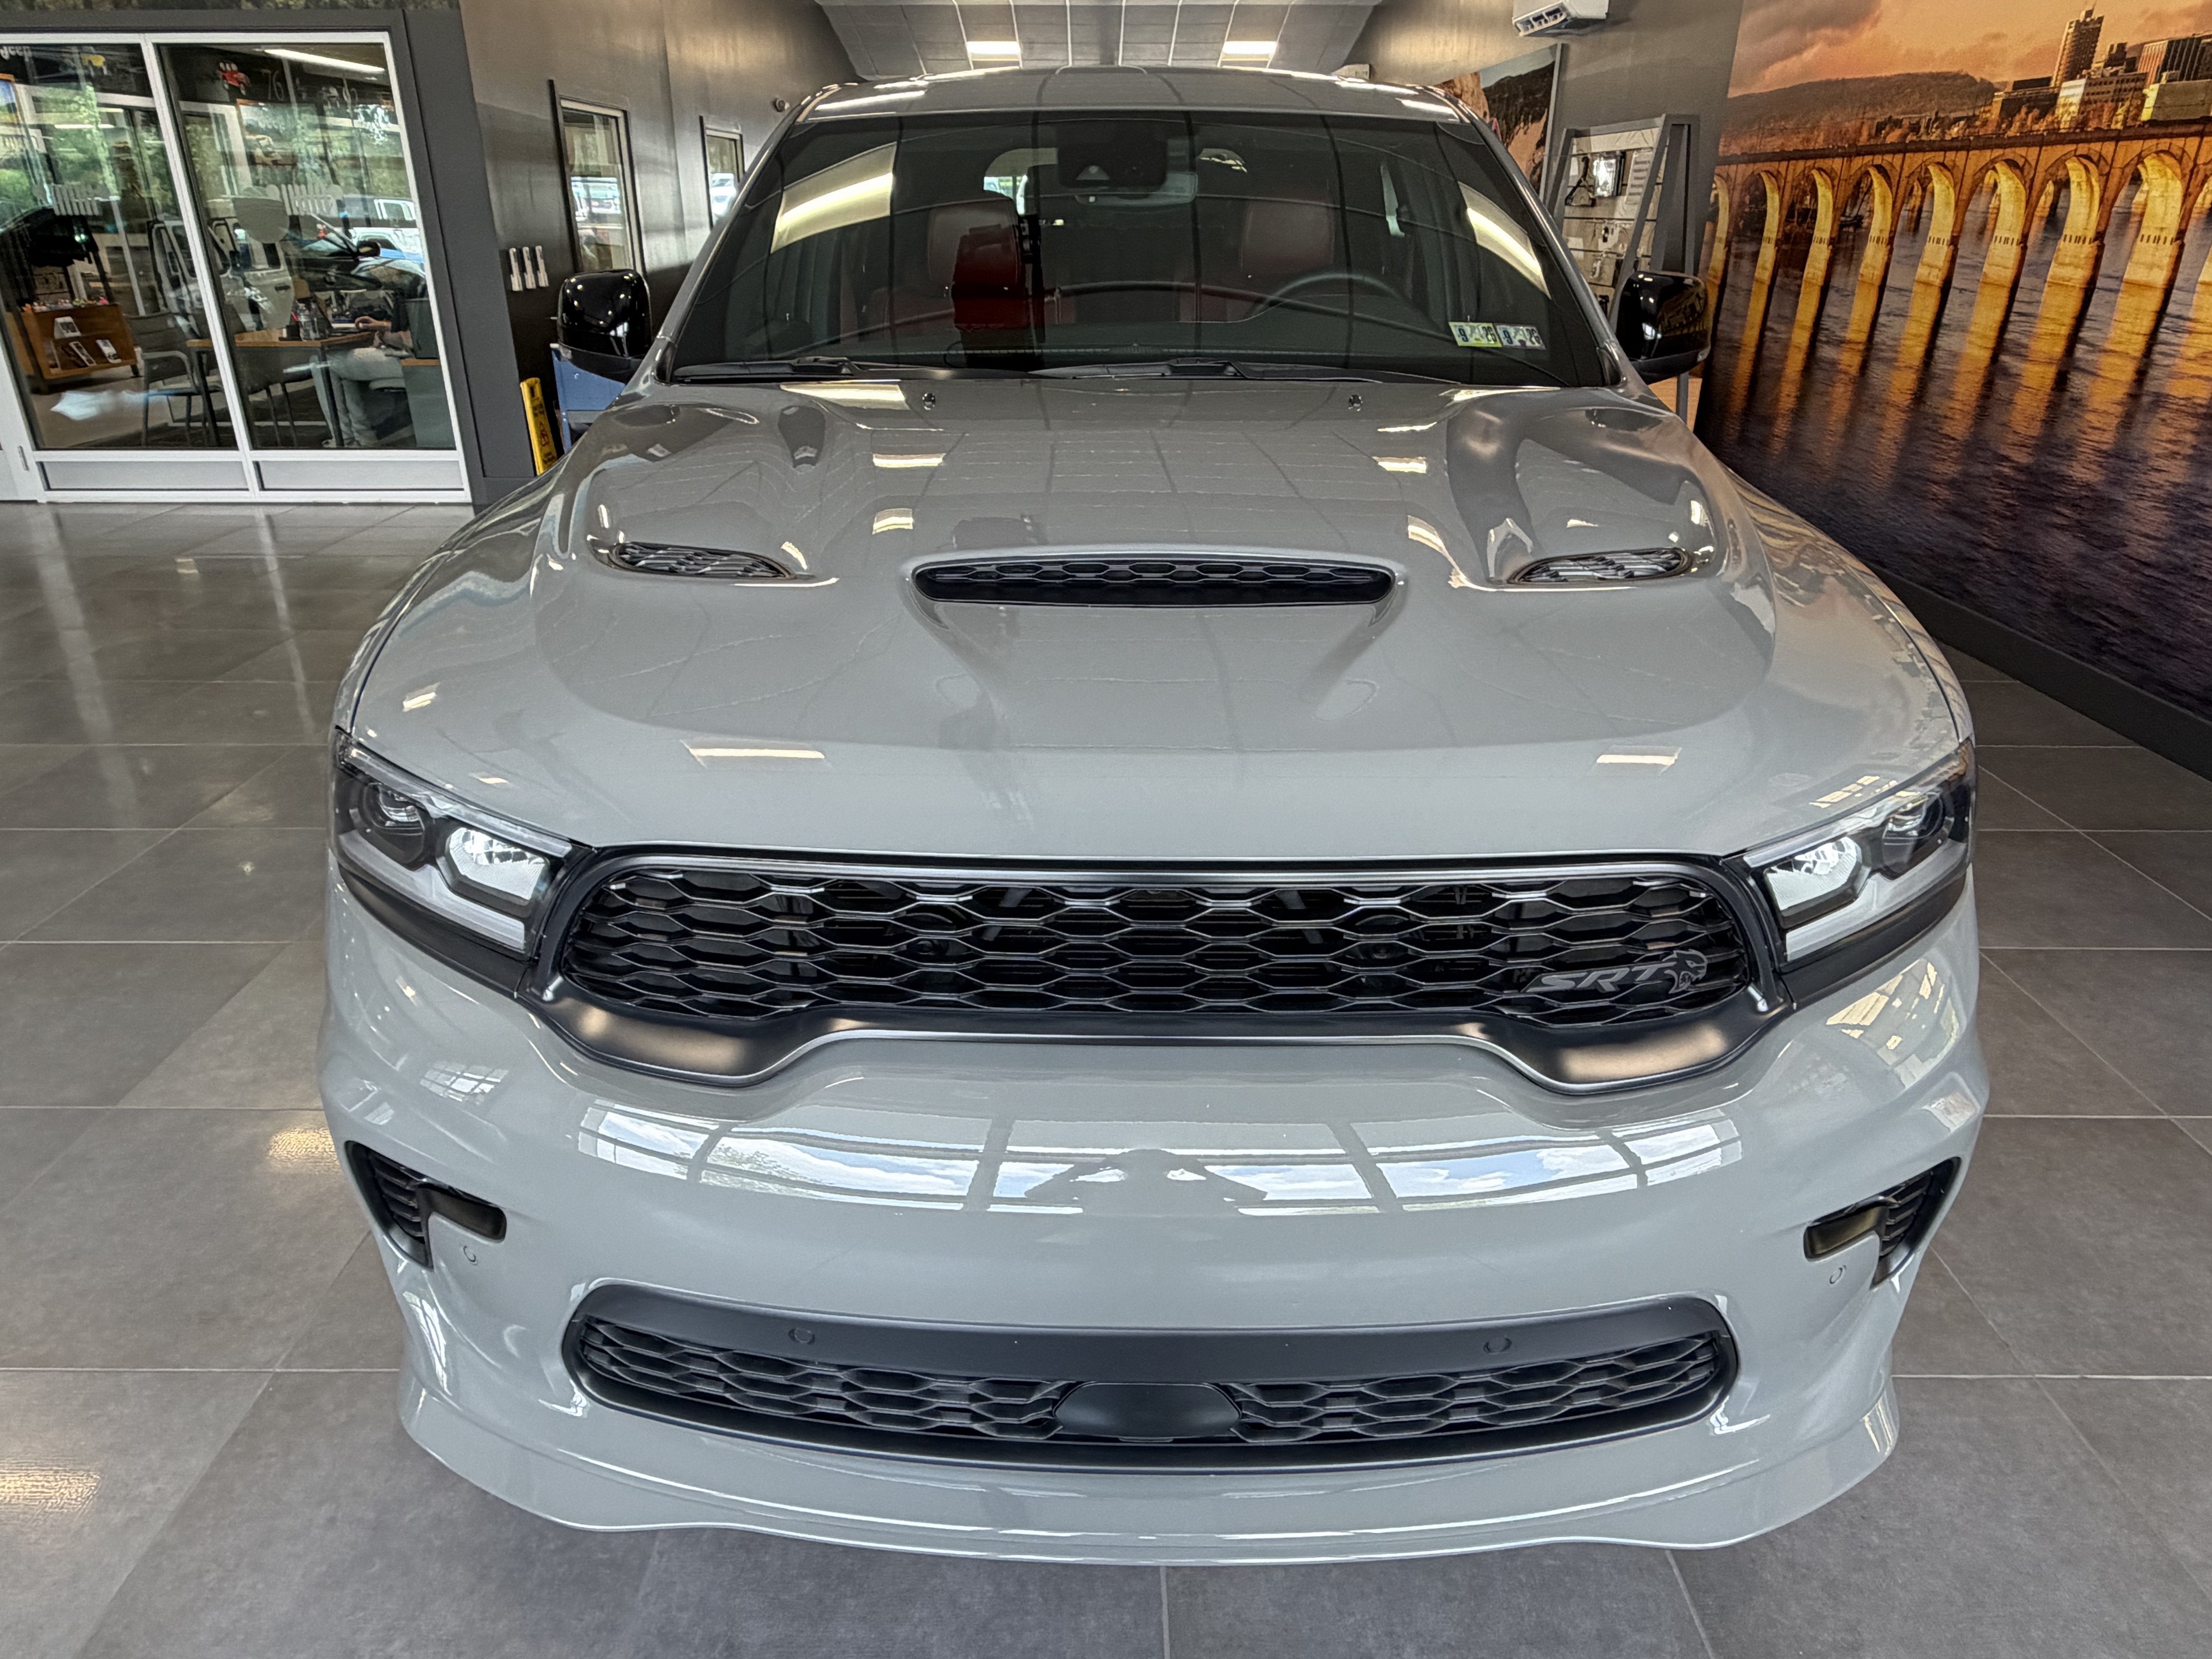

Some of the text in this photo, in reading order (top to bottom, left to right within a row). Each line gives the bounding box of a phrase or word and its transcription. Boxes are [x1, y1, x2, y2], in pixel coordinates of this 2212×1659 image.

[1458, 328, 1469, 342] 9
[1503, 330, 1513, 344] 9
[1526, 961, 1677, 993] SRT
